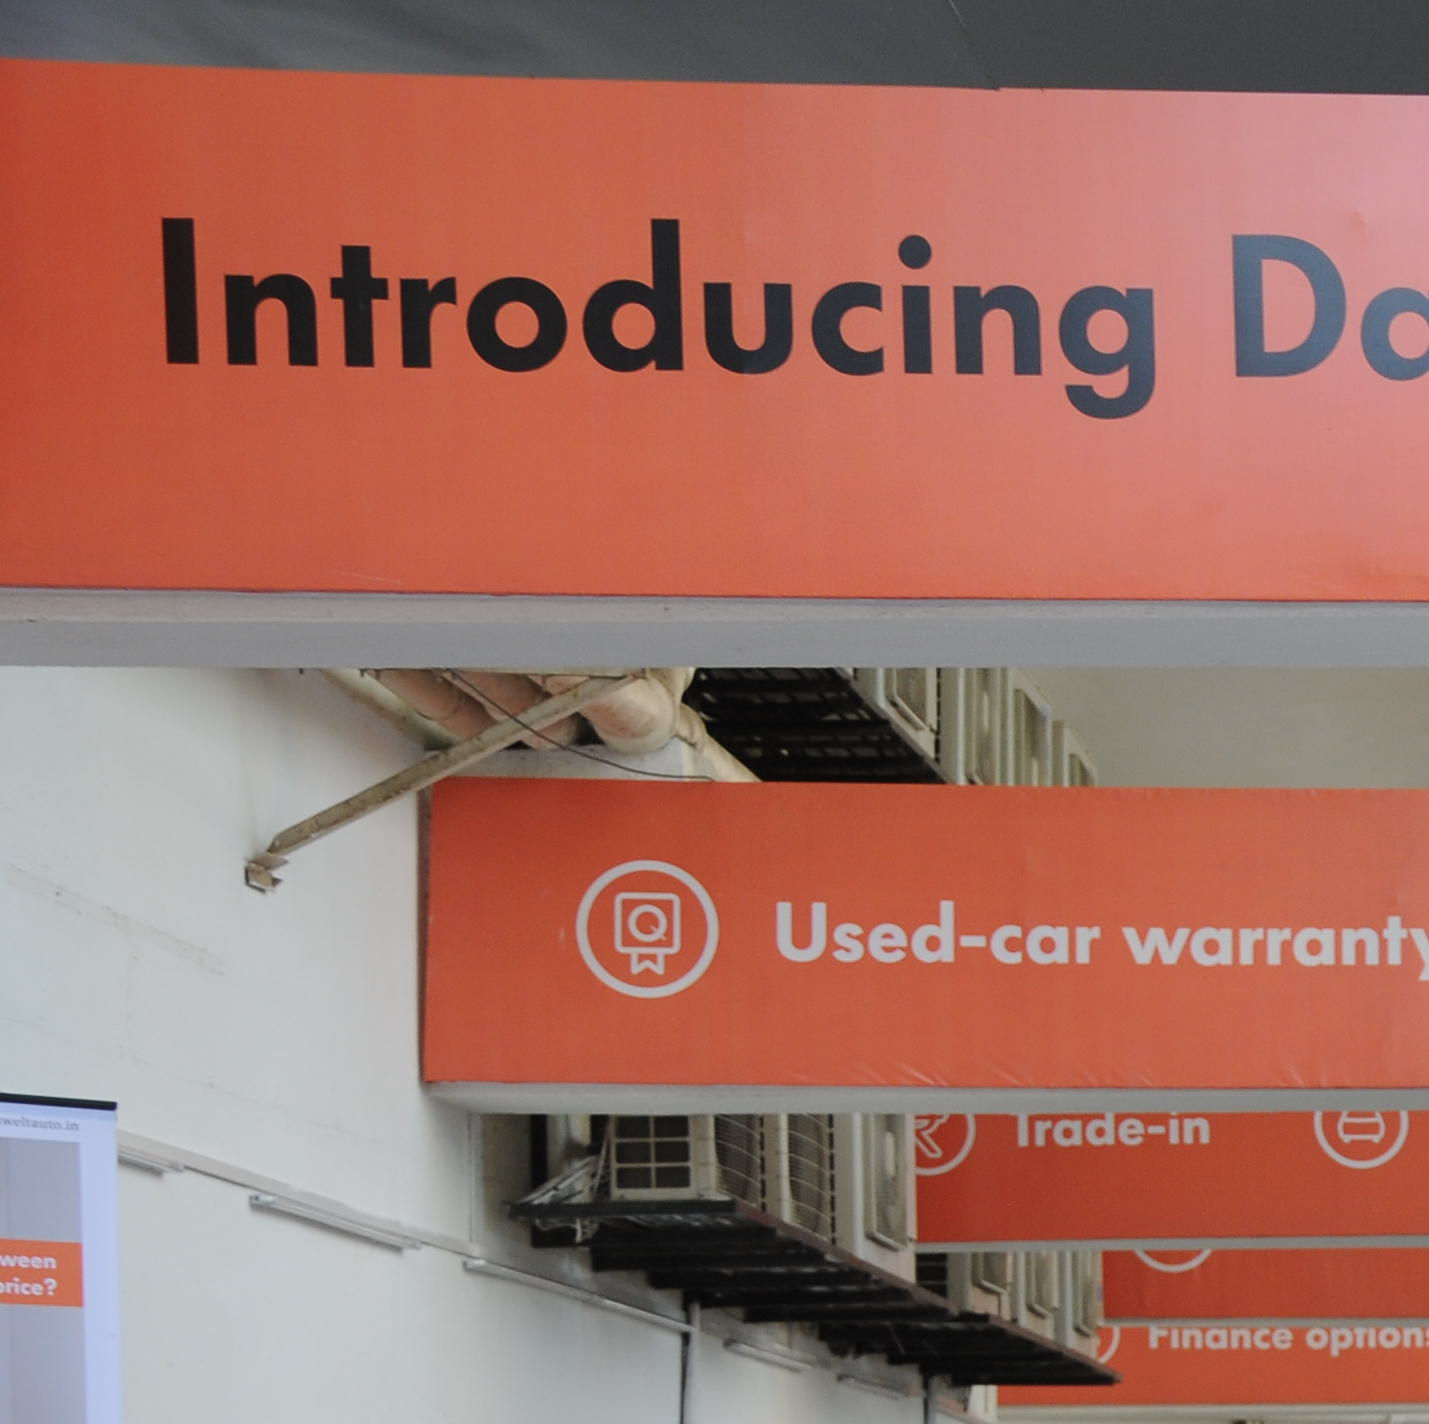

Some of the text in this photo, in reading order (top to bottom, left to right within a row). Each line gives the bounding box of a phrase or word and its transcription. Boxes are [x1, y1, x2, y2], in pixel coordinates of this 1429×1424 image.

[162, 217, 1156, 420] Introducing
[776, 900, 1101, 965] Used-car
[1017, 1113, 1210, 1147] Trade-in
